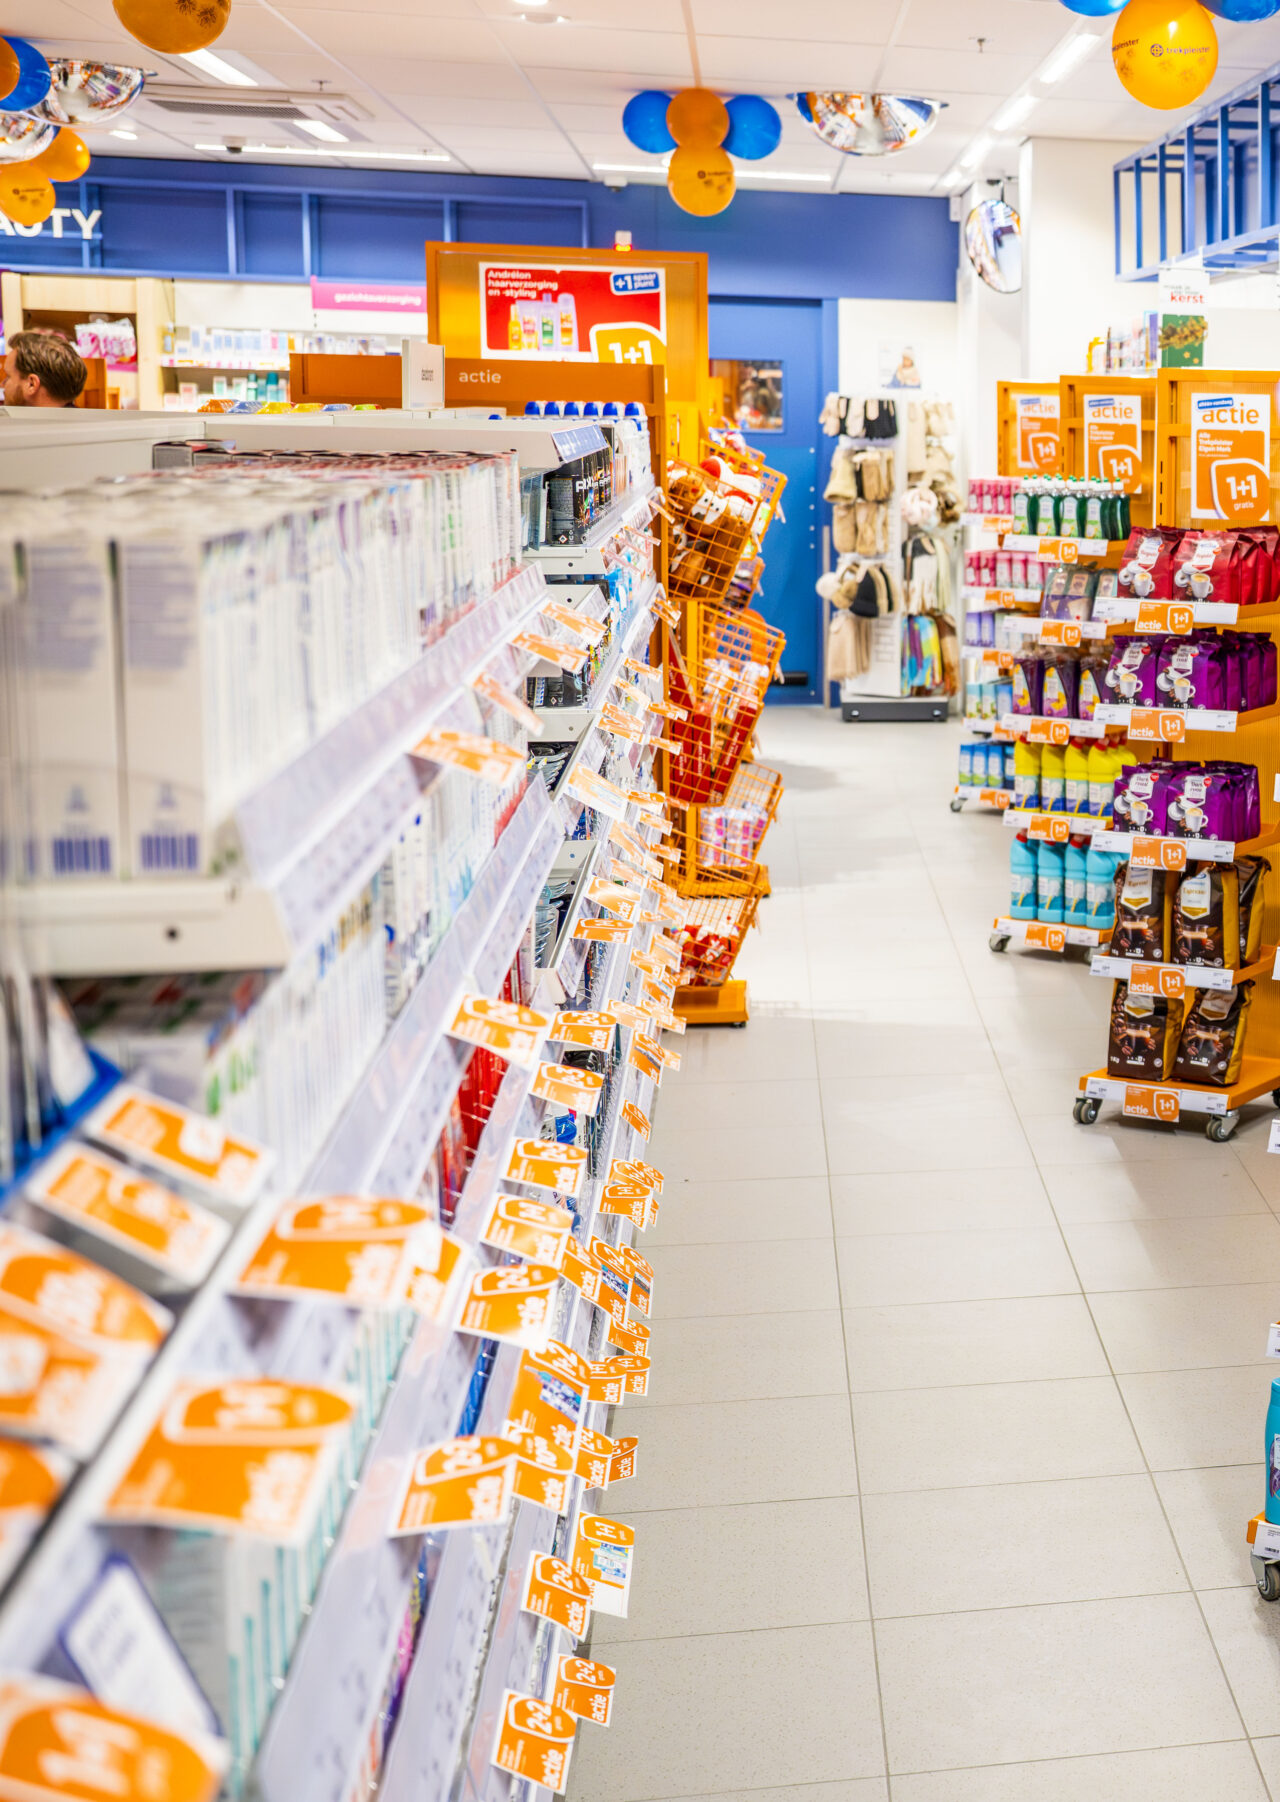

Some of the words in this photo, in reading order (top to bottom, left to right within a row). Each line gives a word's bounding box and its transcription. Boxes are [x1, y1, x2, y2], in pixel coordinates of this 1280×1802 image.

[488, 280, 558, 291] haarverzorging
[616, 276, 633, 290] +1
[1170, 292, 1204, 304] kerst
[609, 340, 653, 364] 1+1
[459, 370, 501, 384] actie
[1092, 403, 1133, 419] actie
[1202, 403, 1260, 424] actie
[1037, 441, 1056, 457] 1+1
[1110, 458, 1133, 477] 1+1
[1226, 474, 1258, 500] 1+1
[1234, 501, 1254, 510] gratis
[1138, 620, 1162, 631] actie
[1173, 612, 1190, 626] 1+1
[1131, 727, 1154, 738] actie
[1165, 720, 1181, 732] 1+1
[1055, 825, 1068, 836] 1+1
[1132, 856, 1155, 865] actie
[1167, 849, 1182, 859] 1+1
[1131, 982, 1154, 993] actie
[1163, 976, 1181, 988] 1+1
[1125, 1104, 1148, 1115] actie
[1159, 1099, 1175, 1110] 1+1
[629, 1201, 643, 1216] actie
[631, 1375, 644, 1393] actie
[602, 1383, 619, 1402] actie
[588, 1460, 604, 1486] actie
[617, 1458, 631, 1477] actie
[595, 1522, 616, 1538] 1+1
[566, 1601, 584, 1632] actie
[575, 1660, 596, 1683] 2+2
[589, 1694, 607, 1721] actie
[526, 1700, 552, 1734] 2+2
[541, 1749, 563, 1788] actie
